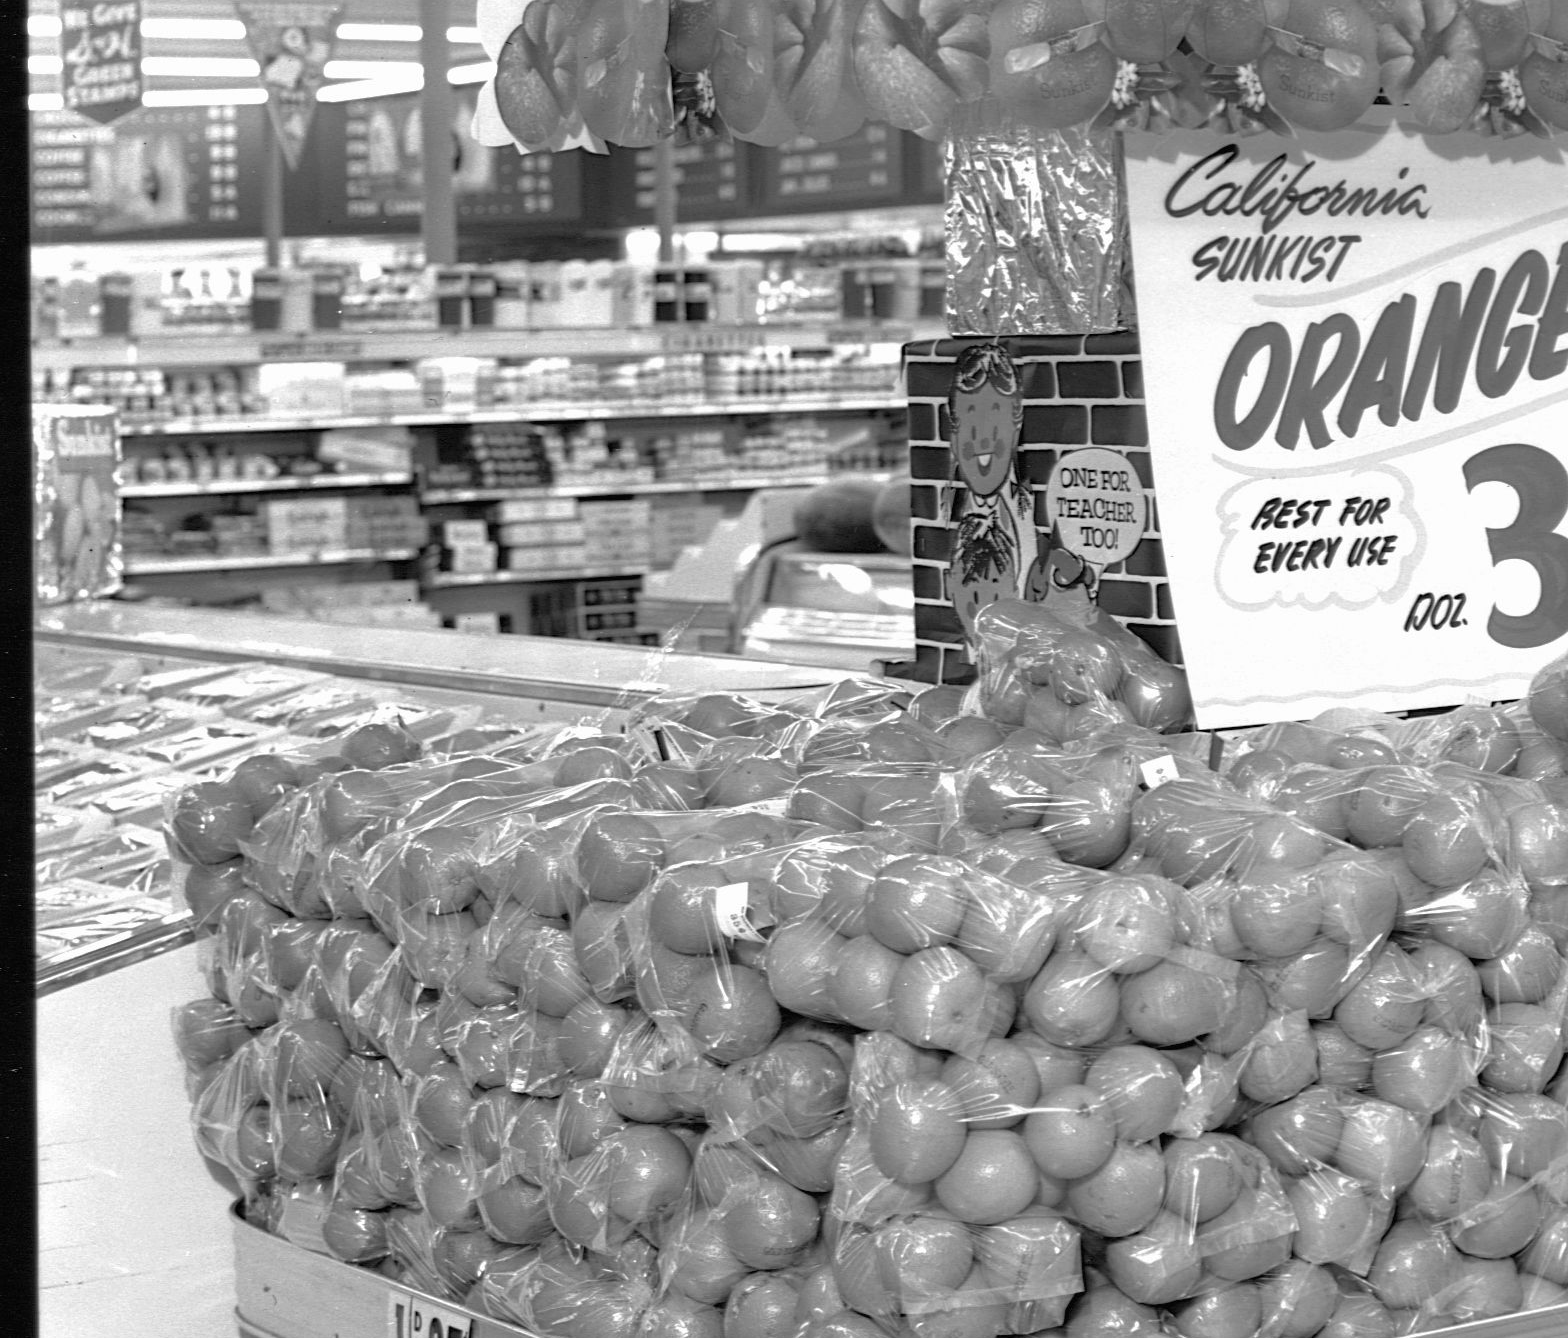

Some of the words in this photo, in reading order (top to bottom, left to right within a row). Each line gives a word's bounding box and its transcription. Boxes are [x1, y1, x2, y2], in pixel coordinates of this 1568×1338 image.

[1165, 143, 1432, 236] California
[1192, 233, 1362, 284] SUNKIST
[1061, 466, 1097, 490] ONE
[1101, 469, 1132, 493] FOR
[1056, 496, 1138, 525] TEACHER
[1251, 495, 1331, 531] BEST
[1343, 494, 1392, 527] FOR
[1080, 525, 1120, 551] TOO!
[1254, 537, 1341, 574] EVERY
[1346, 534, 1399, 567] USE
